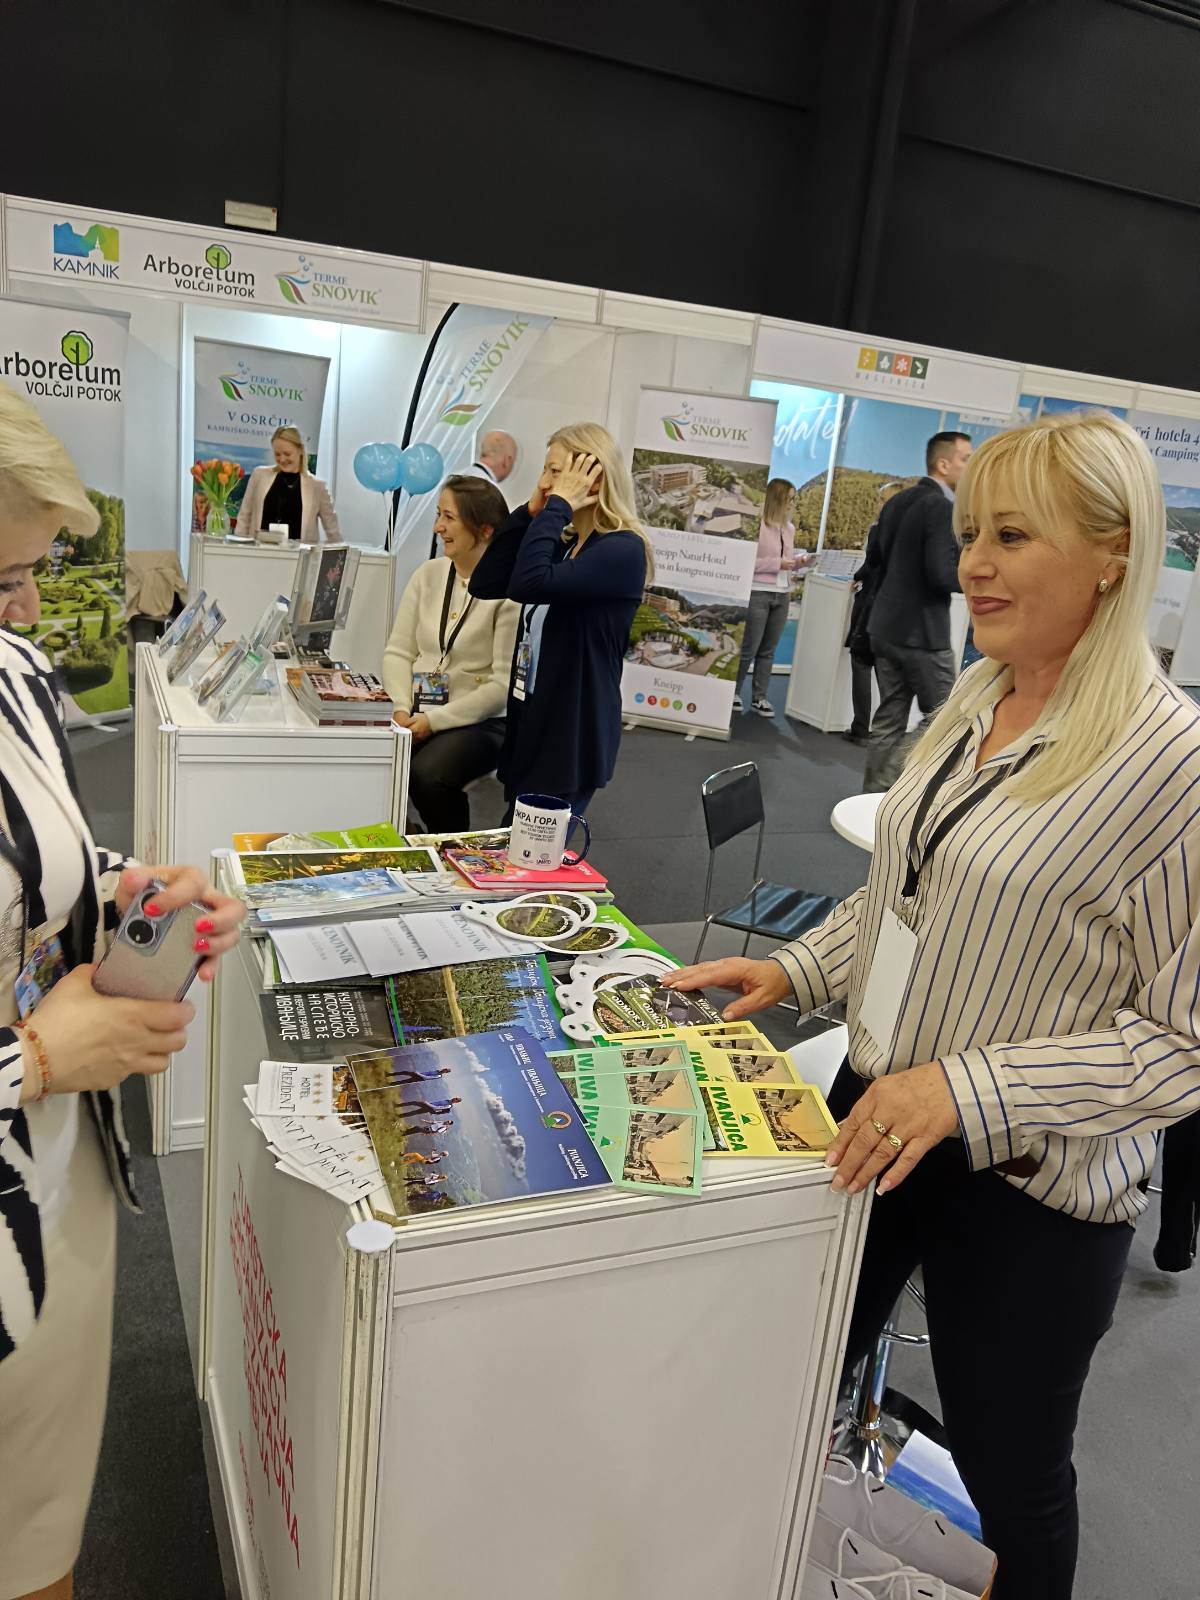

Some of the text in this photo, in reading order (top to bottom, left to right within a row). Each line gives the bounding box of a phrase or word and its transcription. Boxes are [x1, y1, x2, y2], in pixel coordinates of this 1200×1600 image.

[53, 256, 120, 280] KAMNIK
[143, 253, 256, 286] Arboretum
[312, 272, 348, 286] TERME
[174, 277, 256, 299] VOLČJI POTOK
[311, 283, 378, 305] SNOVIK
[459, 339, 492, 378] TERME
[467, 314, 530, 392] SNOVIK
[0, 352, 122, 386] rboretum
[250, 375, 279, 386] TERME
[26, 380, 122, 402] VOLČJI POTOK
[248, 384, 304, 402] SNOVIK
[689, 424, 749, 442] SNOVIK
[1155, 427, 1191, 443] hotela
[653, 677, 685, 693] Kneipp
[533, 815, 558, 826] ГОРА
[321, 926, 356, 965] CENOVNIK
[275, 995, 300, 1041] ИВАЊИЦЕ
[323, 992, 346, 1039] ИСТОРИЈСКО
[337, 991, 360, 1037] КУЛТУРНО-
[300, 1077, 311, 1099] HOTEL
[710, 1086, 748, 1152] IVANJICA
[567, 1148, 589, 1179] IVANJICA
